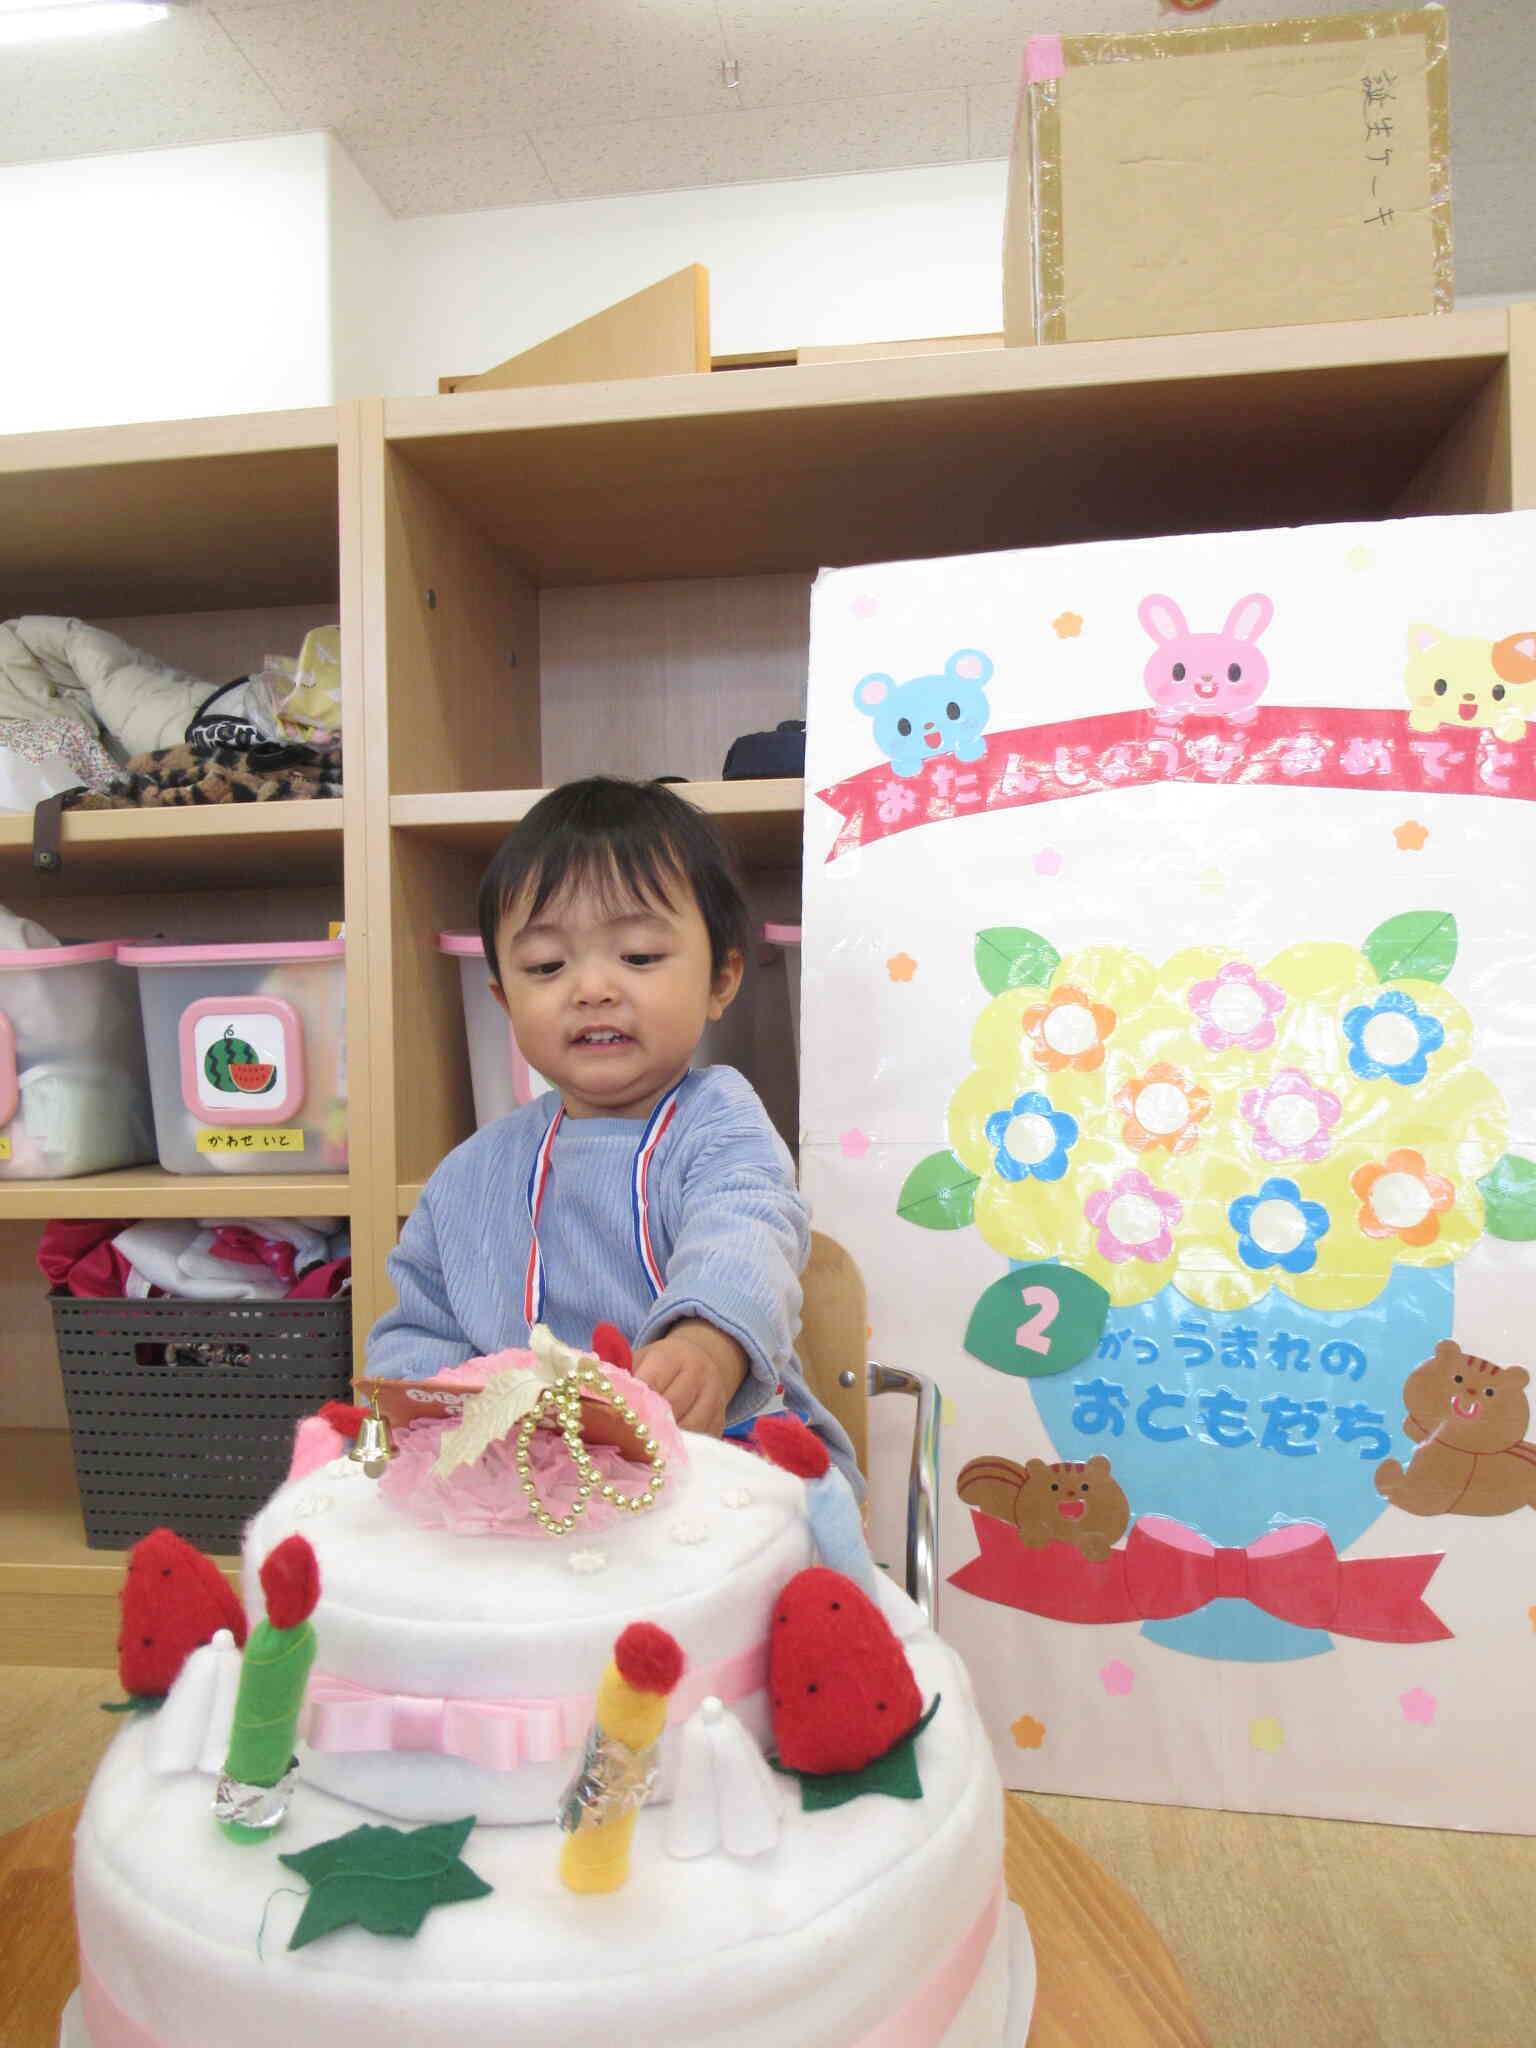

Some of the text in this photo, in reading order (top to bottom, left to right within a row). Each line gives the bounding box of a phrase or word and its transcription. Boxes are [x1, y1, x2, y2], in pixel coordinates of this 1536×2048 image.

[875, 725, 1536, 824] おたんじょうびおめでと
[1071, 1377, 1392, 1460] おともだち
